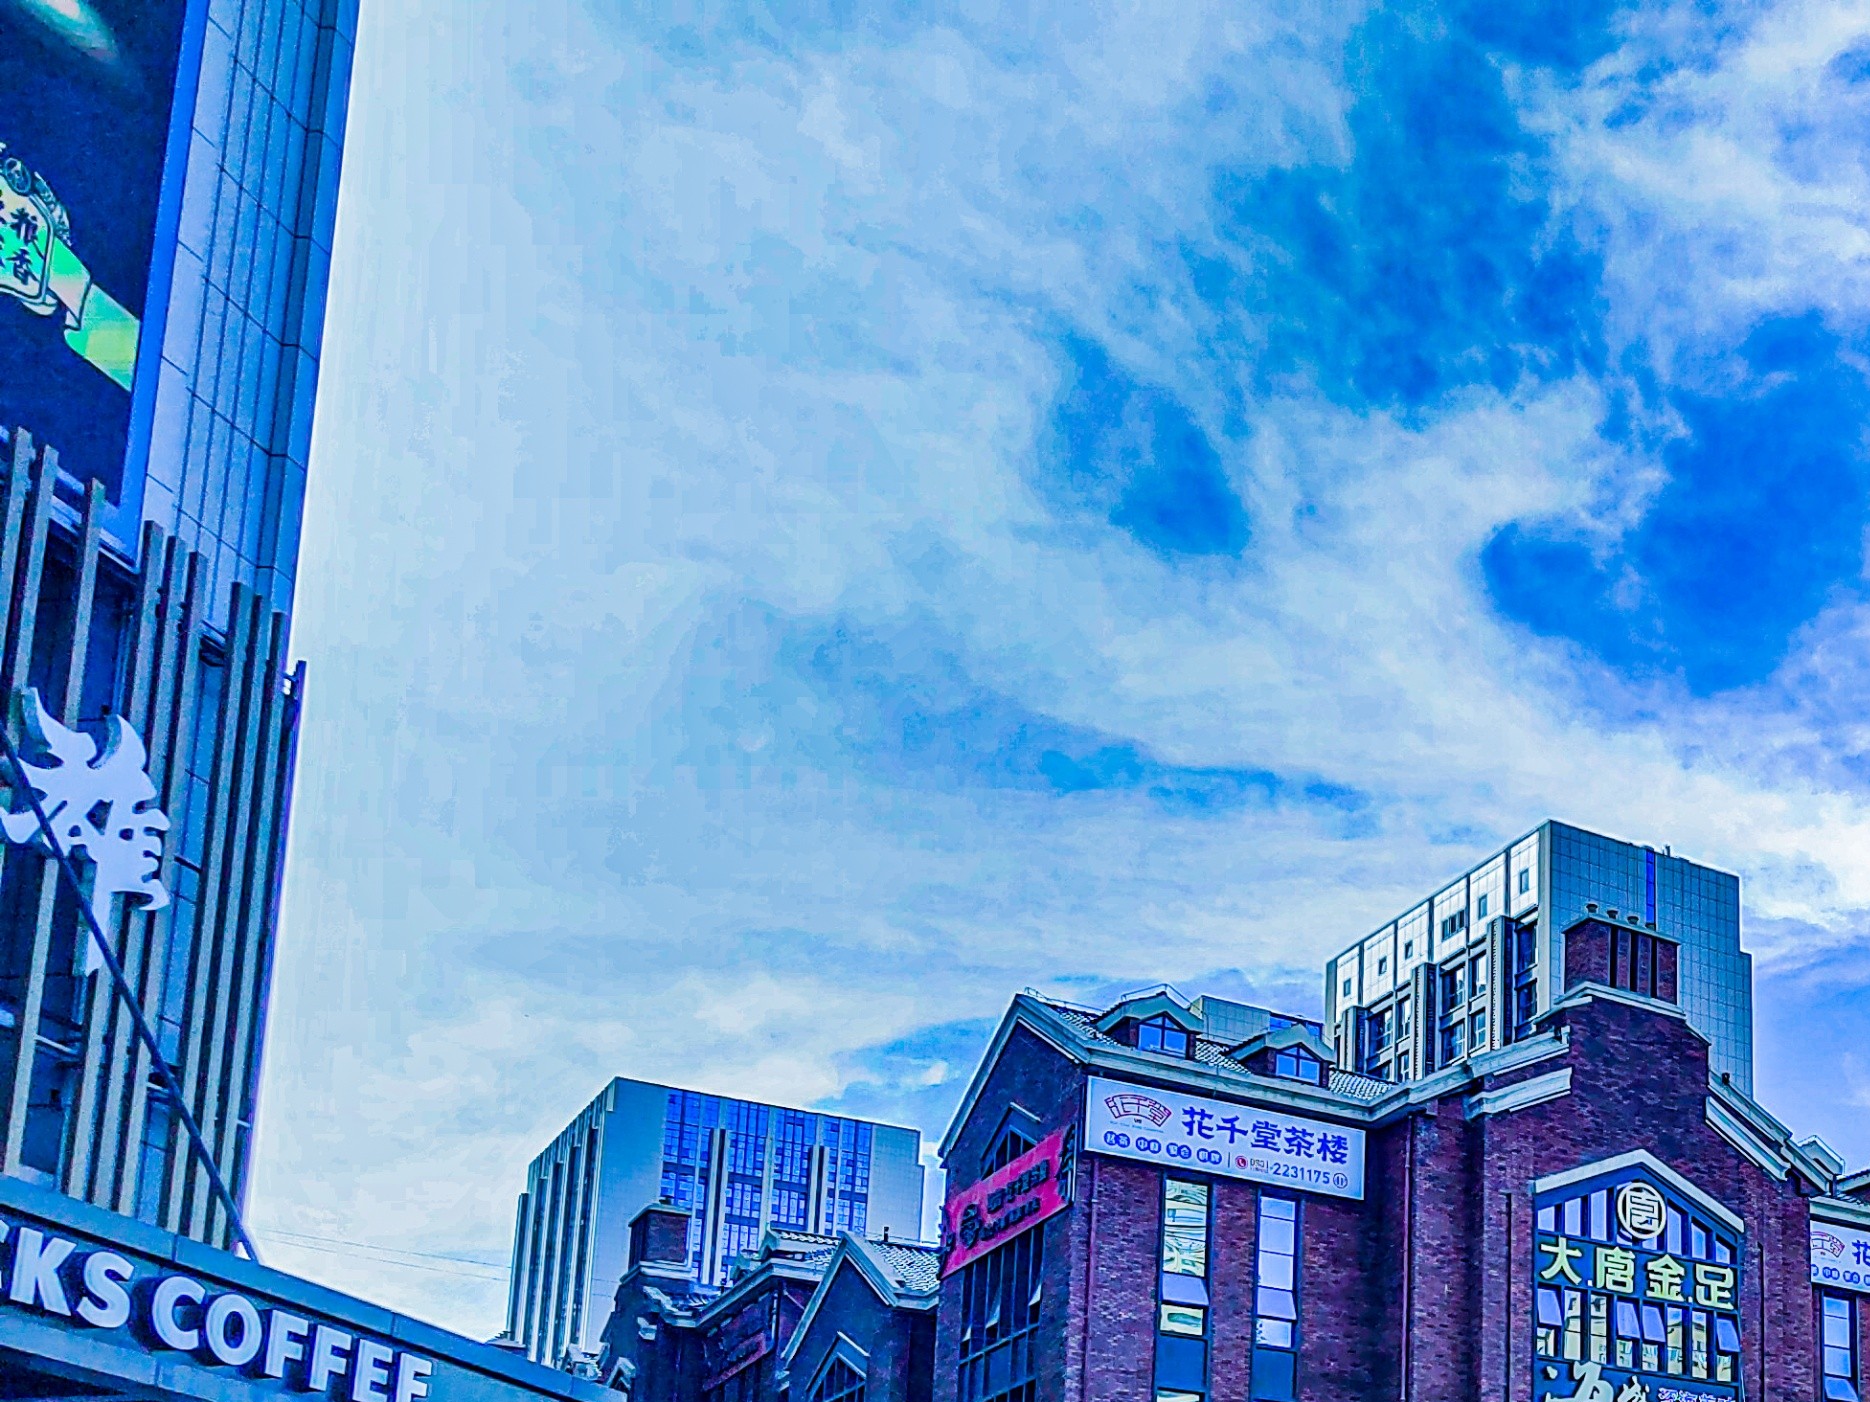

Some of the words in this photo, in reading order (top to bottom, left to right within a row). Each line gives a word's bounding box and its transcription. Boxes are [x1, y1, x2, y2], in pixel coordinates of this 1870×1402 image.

[1182, 1106, 1349, 1165] 花千堂茶楼
[0, 1221, 135, 1329] KS
[1540, 1236, 1734, 1310] 大唐金足
